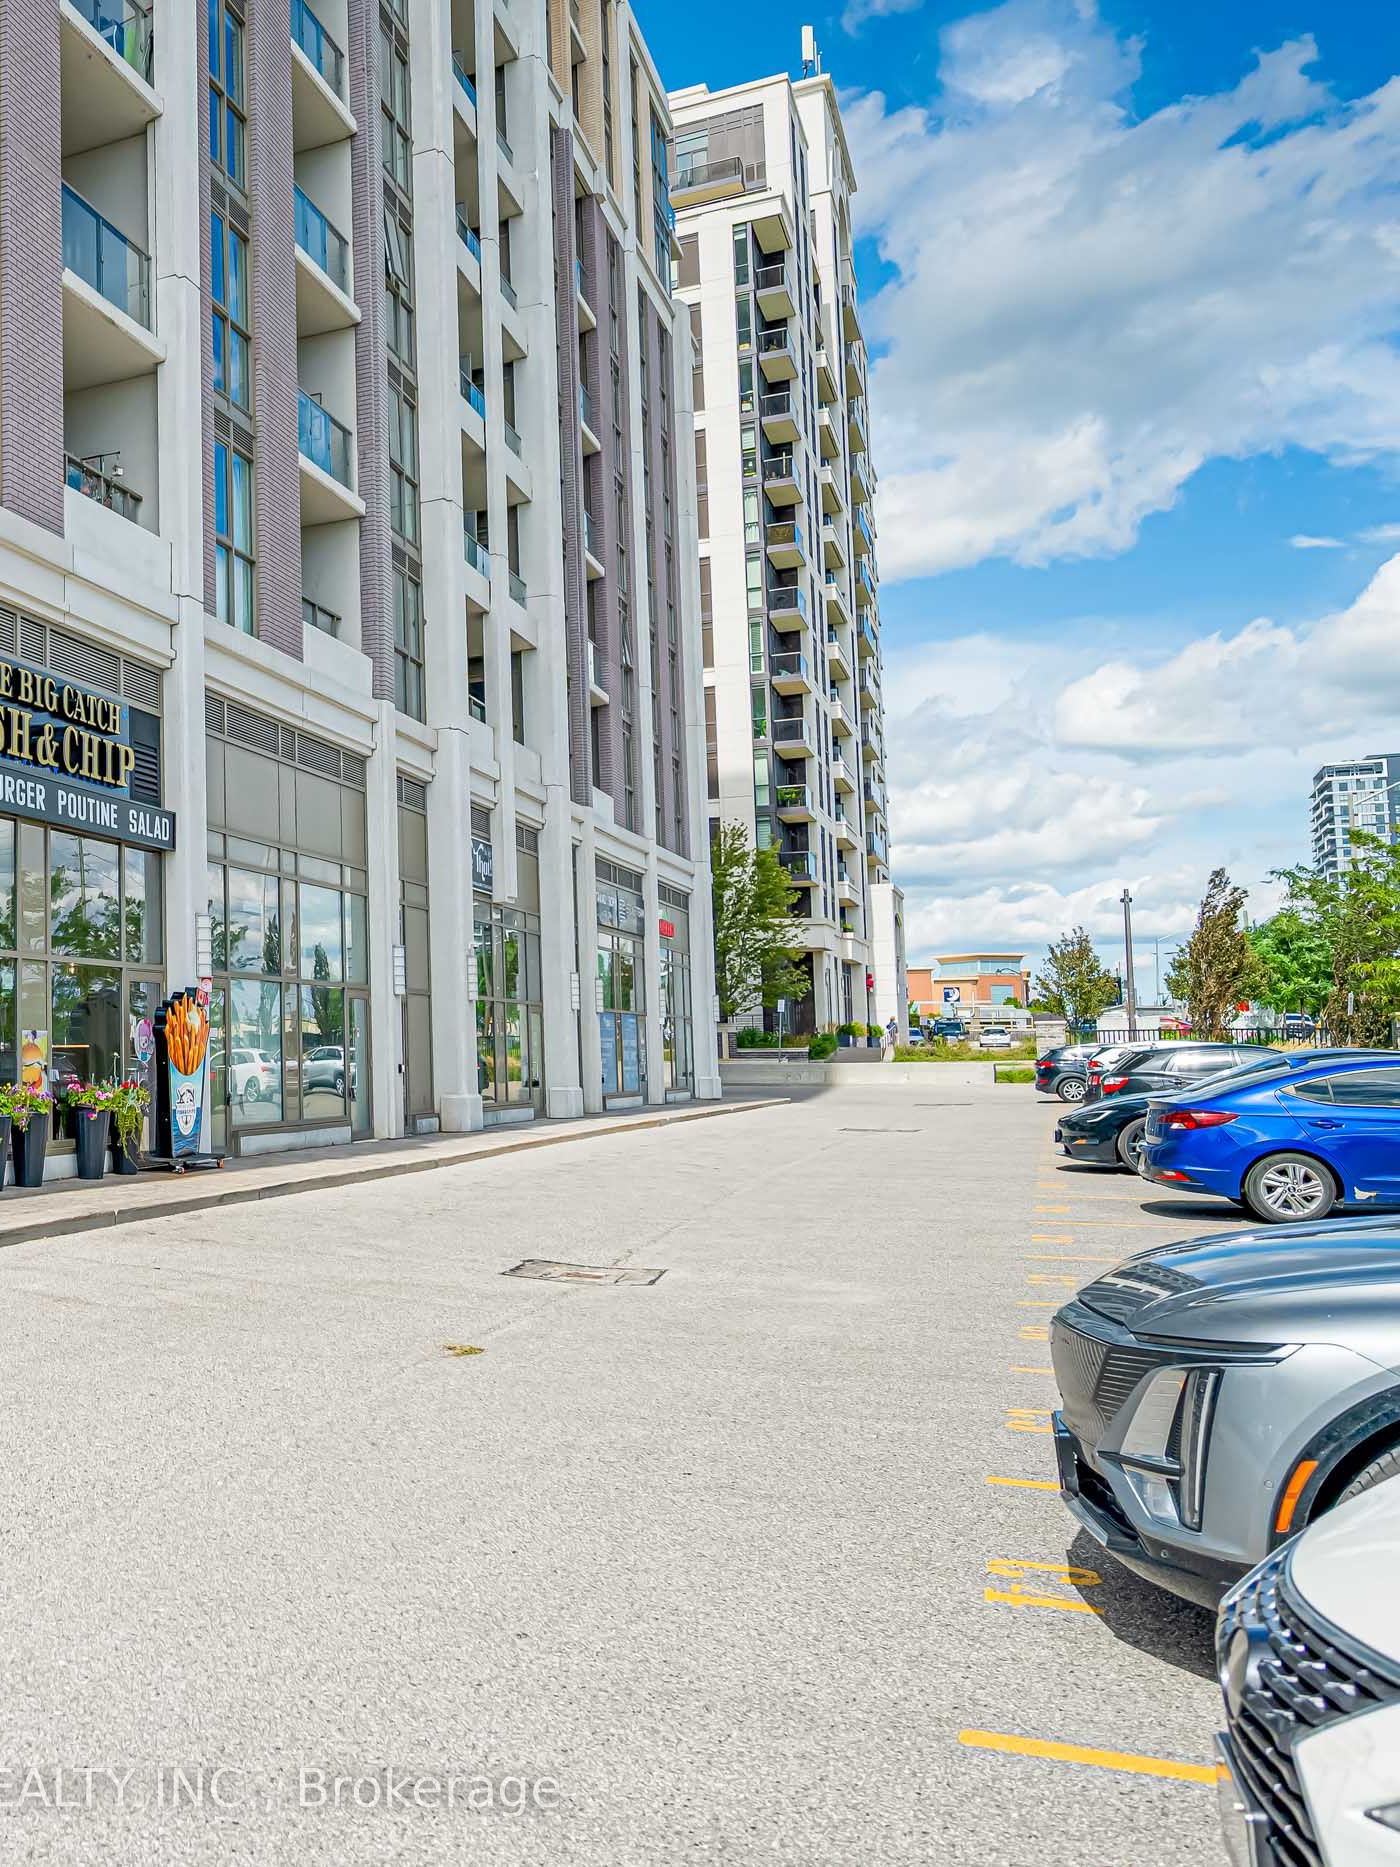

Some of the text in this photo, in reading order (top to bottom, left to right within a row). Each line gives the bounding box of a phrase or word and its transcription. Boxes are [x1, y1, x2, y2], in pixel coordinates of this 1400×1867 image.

[18, 667, 59, 713] BIG
[63, 684, 121, 735] CATCH
[36, 723, 59, 767] &
[62, 725, 136, 787] CHIP
[57, 789, 119, 829] POUTINE
[129, 809, 170, 842] SALAD
